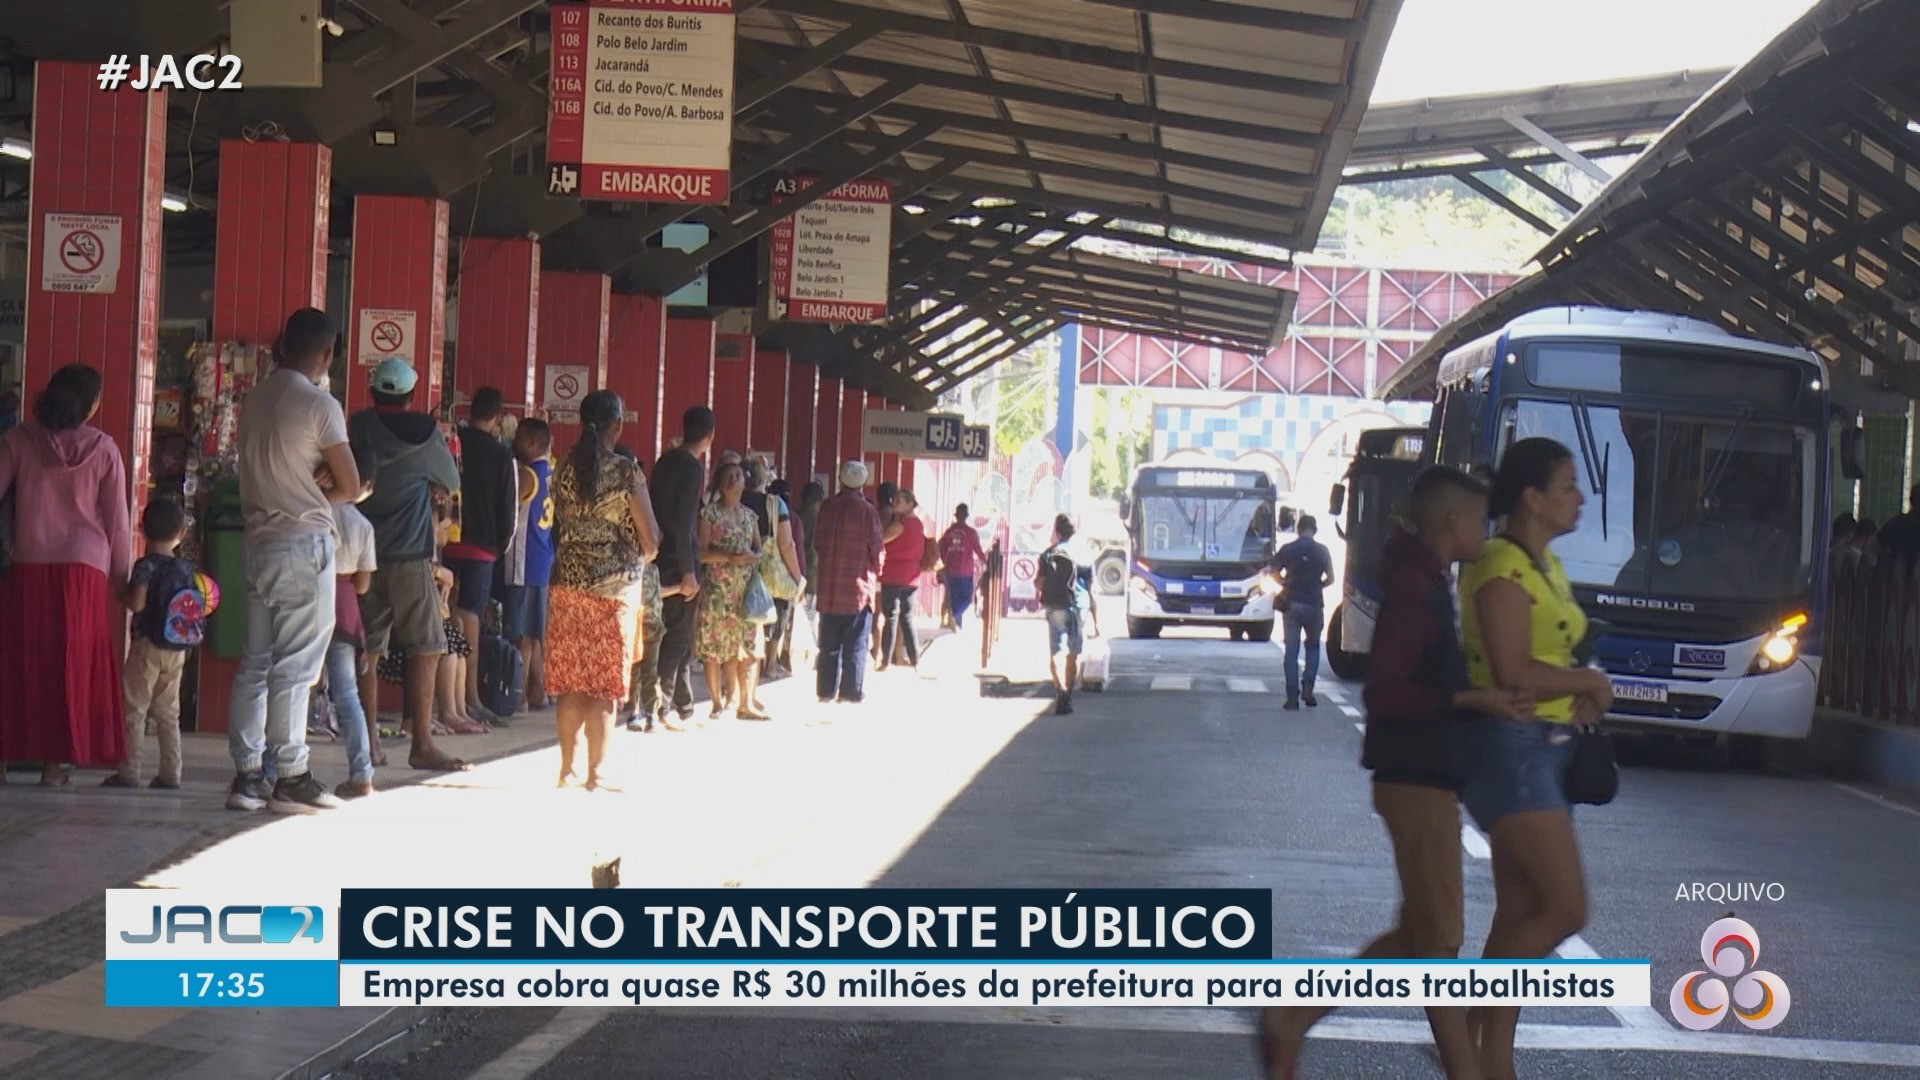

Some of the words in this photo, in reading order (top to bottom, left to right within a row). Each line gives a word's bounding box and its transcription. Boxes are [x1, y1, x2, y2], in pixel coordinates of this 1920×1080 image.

[561, 11, 581, 25] 107
[598, 13, 641, 28] Recanto
[645, 15, 664, 29] dos
[667, 16, 702, 30] Buritis
[560, 34, 580, 46] 108
[597, 35, 621, 49] Polo
[624, 36, 648, 50] Belo
[651, 38, 688, 52] Jardim
[559, 56, 578, 69] 113
[595, 57, 649, 72] Jacarandá
[554, 78, 581, 92] 116A
[594, 79, 615, 94] Cid.
[618, 81, 632, 94] do
[636, 81, 678, 96] Povo/C.
[681, 83, 724, 98] Mendes
[554, 100, 580, 114] 116B
[594, 102, 614, 116] Cid.
[617, 102, 631, 116] do
[635, 103, 677, 119] Povo/A.
[681, 105, 724, 121] Barbosa
[601, 170, 711, 199] EMBARQUE
[775, 179, 797, 194] A3
[815, 231, 833, 241] Praia
[834, 232, 844, 242] do
[799, 245, 833, 255] Liberdade
[798, 258, 814, 268] Polo
[797, 273, 812, 282] Belo
[814, 274, 838, 284] Jardim
[796, 287, 812, 297] Belo
[813, 288, 838, 298] Jardim
[802, 303, 874, 324] EMBARQUE
[870, 425, 923, 437] DESEMBARQUE
[1596, 593, 1695, 612] NEOBUS
